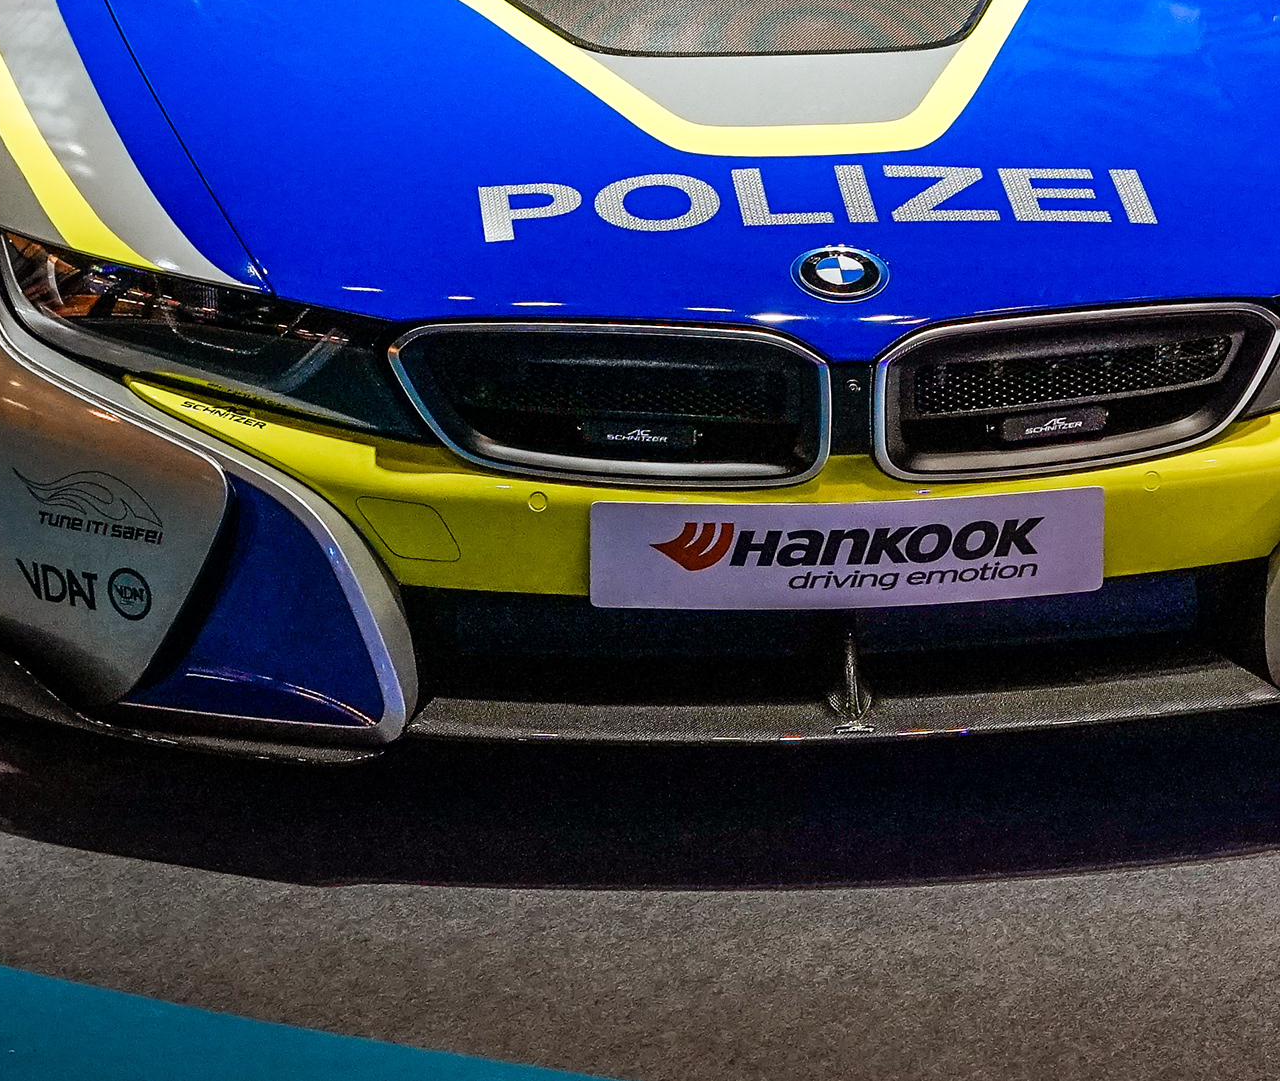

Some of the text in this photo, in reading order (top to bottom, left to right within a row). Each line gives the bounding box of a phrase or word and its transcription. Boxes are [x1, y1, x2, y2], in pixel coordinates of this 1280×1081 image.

[477, 163, 1158, 243] POLIZEI
[180, 400, 267, 430] SCHNITZER
[1025, 421, 1082, 434] SCHNITZER
[15, 558, 98, 610] VDAT
[788, 561, 1039, 591] driving emotion
